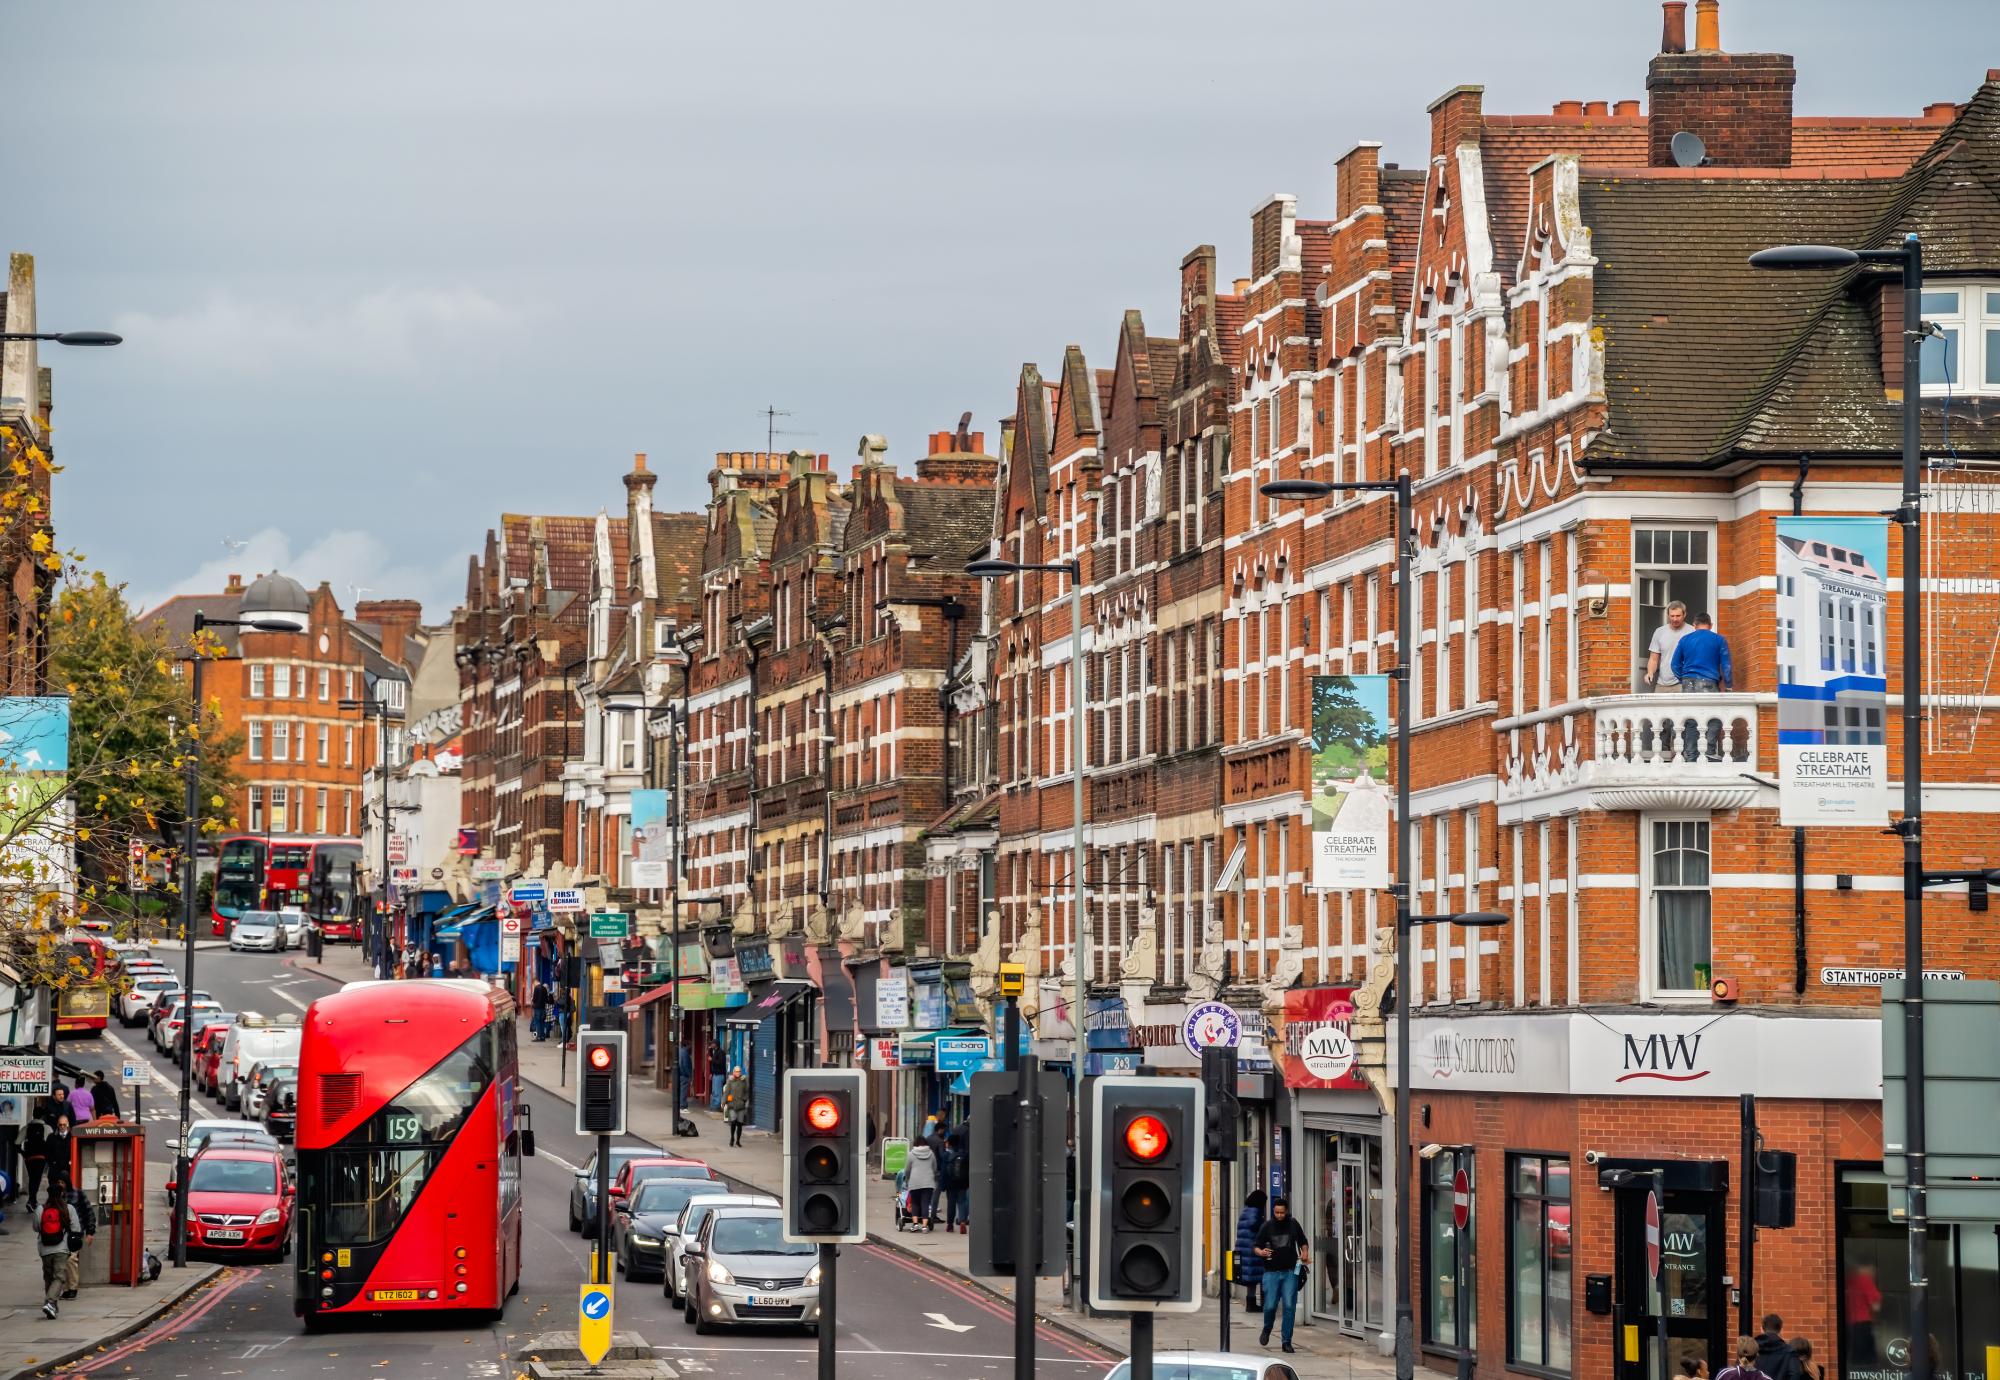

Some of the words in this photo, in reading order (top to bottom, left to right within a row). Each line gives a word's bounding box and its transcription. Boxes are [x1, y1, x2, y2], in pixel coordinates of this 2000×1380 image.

[1821, 583, 1861, 597] STREATHAM
[1863, 593, 1877, 601] HILL
[1799, 752, 1868, 763] CELEBRATE
[1796, 765, 1871, 775] STREATHAM
[1326, 836, 1375, 845] CELEBRATE
[1323, 845, 1377, 854] STREATHAM
[950, 1041, 984, 1049] Lebara
[1309, 1038, 1346, 1054] MW
[1623, 1033, 1702, 1070] MW
[1310, 1061, 1346, 1069] streatham
[12, 1071, 46, 1080] LICENCE
[13, 1083, 28, 1092] TILL
[30, 1083, 48, 1092] LATE
[389, 1117, 419, 1140] 159
[1664, 1263, 1696, 1271] NTRANCE
[379, 1291, 393, 1299] LTZ
[395, 1291, 413, 1299] 1602
[753, 1297, 774, 1305] LL60
